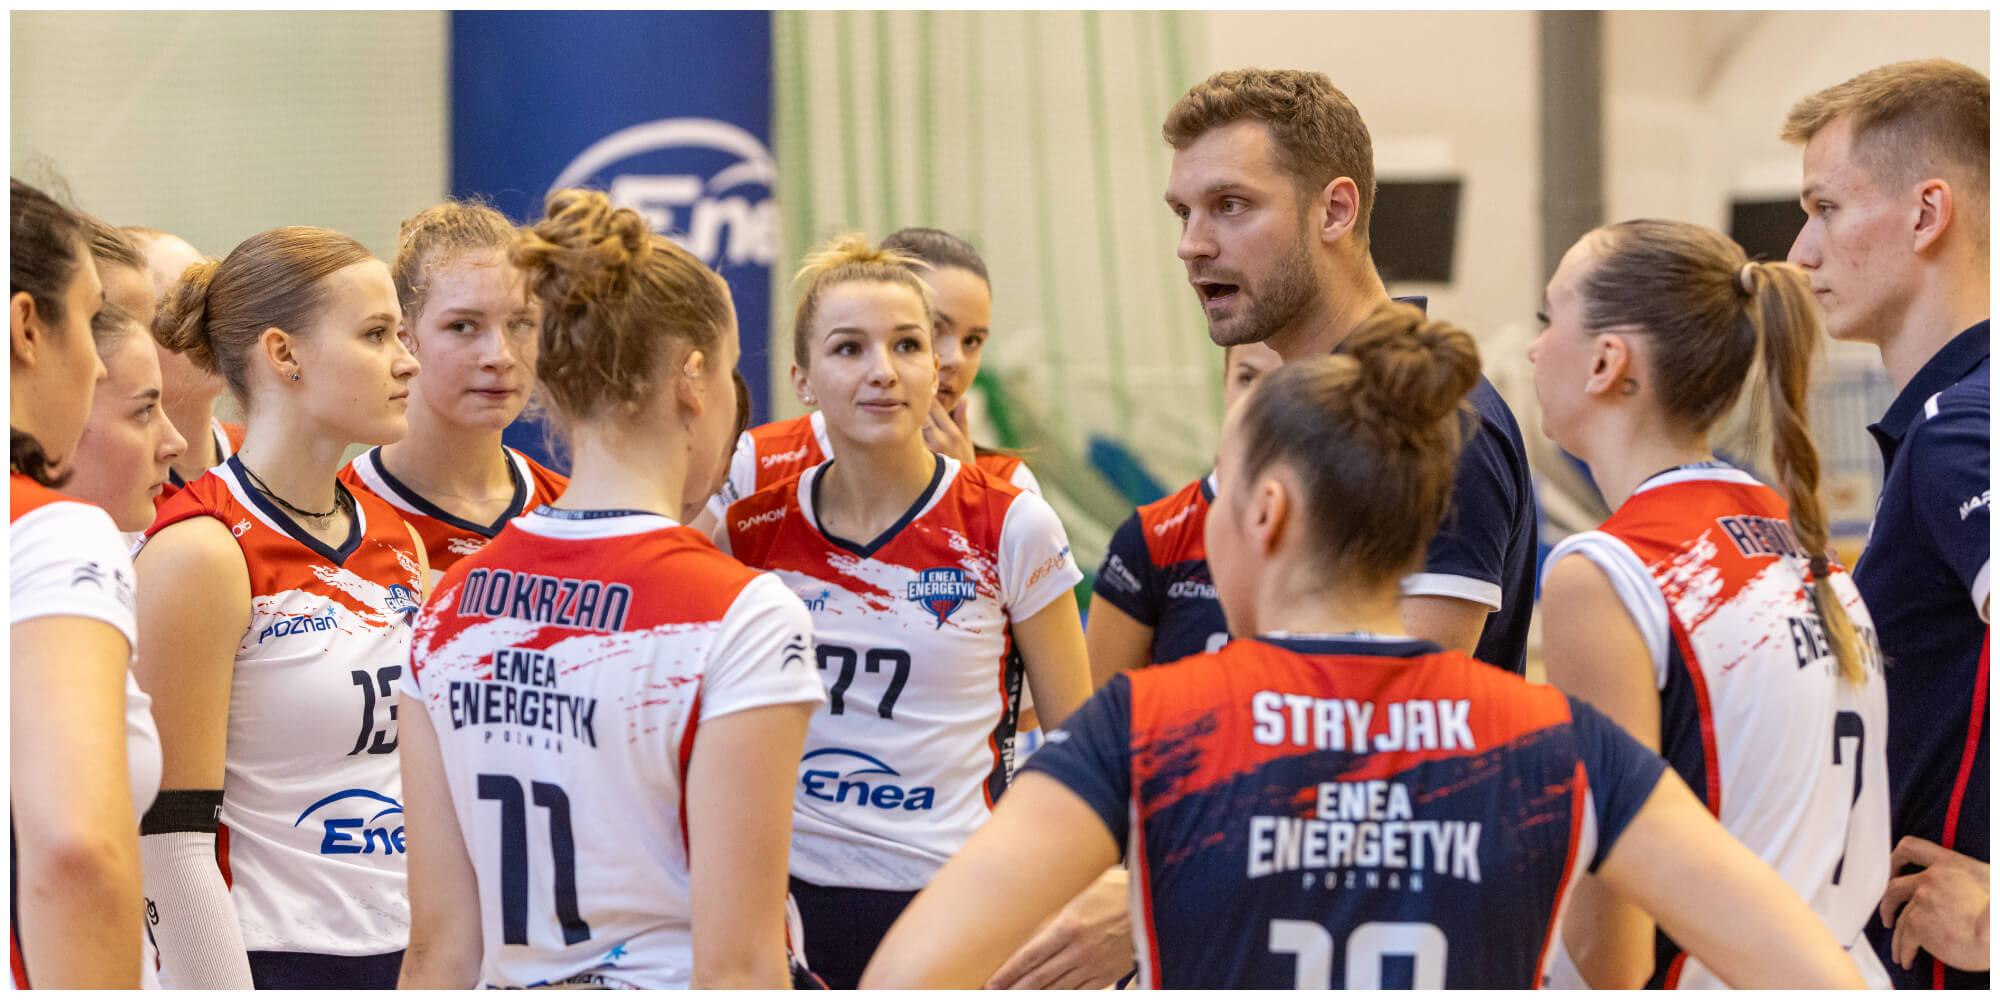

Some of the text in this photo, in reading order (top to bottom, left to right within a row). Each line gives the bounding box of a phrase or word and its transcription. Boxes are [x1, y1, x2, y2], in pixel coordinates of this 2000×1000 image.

[457, 567, 633, 632] MOKRZAN
[908, 581, 976, 599] ENERGETYK
[928, 571, 957, 582] ENEA
[495, 650, 557, 688] ENEA
[815, 643, 911, 720] 77
[450, 681, 598, 749] ENERGETYK
[1252, 690, 1475, 754] STRYJAK
[802, 770, 935, 811] Enea
[1317, 779, 1413, 820] ENEA
[1832, 710, 1865, 885] 7
[477, 773, 591, 946] 11
[1247, 815, 1482, 884] ENERGETYK
